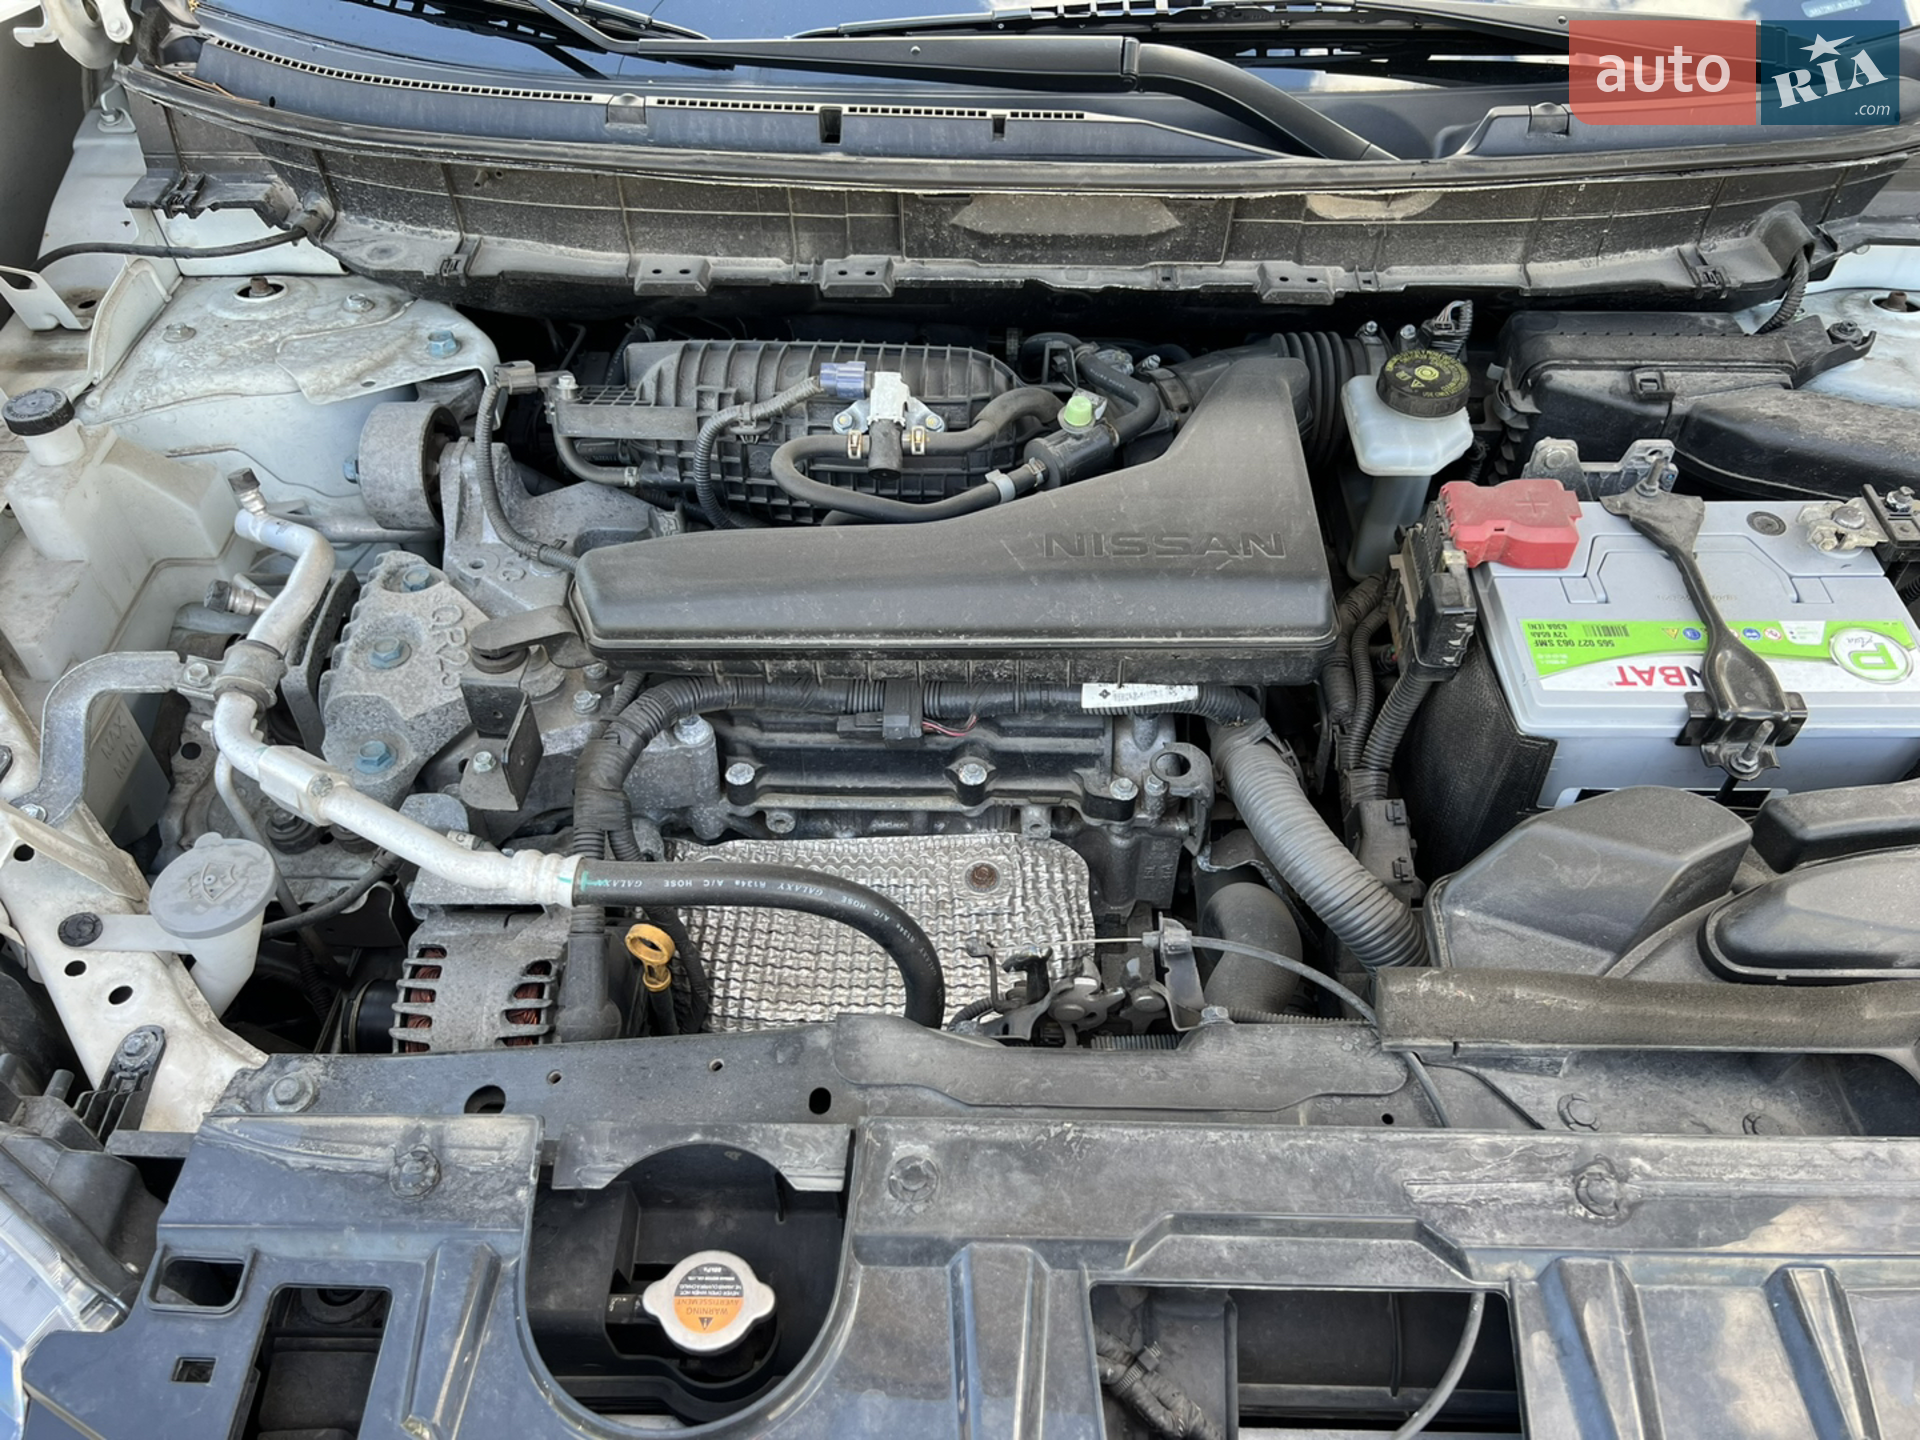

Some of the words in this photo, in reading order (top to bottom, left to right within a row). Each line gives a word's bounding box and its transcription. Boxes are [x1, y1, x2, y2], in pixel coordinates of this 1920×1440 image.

[1043, 532, 1286, 559] NISSAN
[1534, 639, 1555, 648] SMF
[1557, 639, 1575, 648] 063
[1578, 639, 1595, 648] 027
[1596, 639, 1615, 648] 565
[101, 715, 127, 760] MAX
[113, 733, 139, 780] MIN
[663, 879, 693, 888] HOSE
[703, 879, 724, 888] A/C
[735, 879, 766, 889] R134a
[777, 882, 824, 897] GALAXY
[841, 895, 867, 910] HOSE
[873, 908, 890, 922] A/C
[685, 1306, 729, 1316] WARNING
